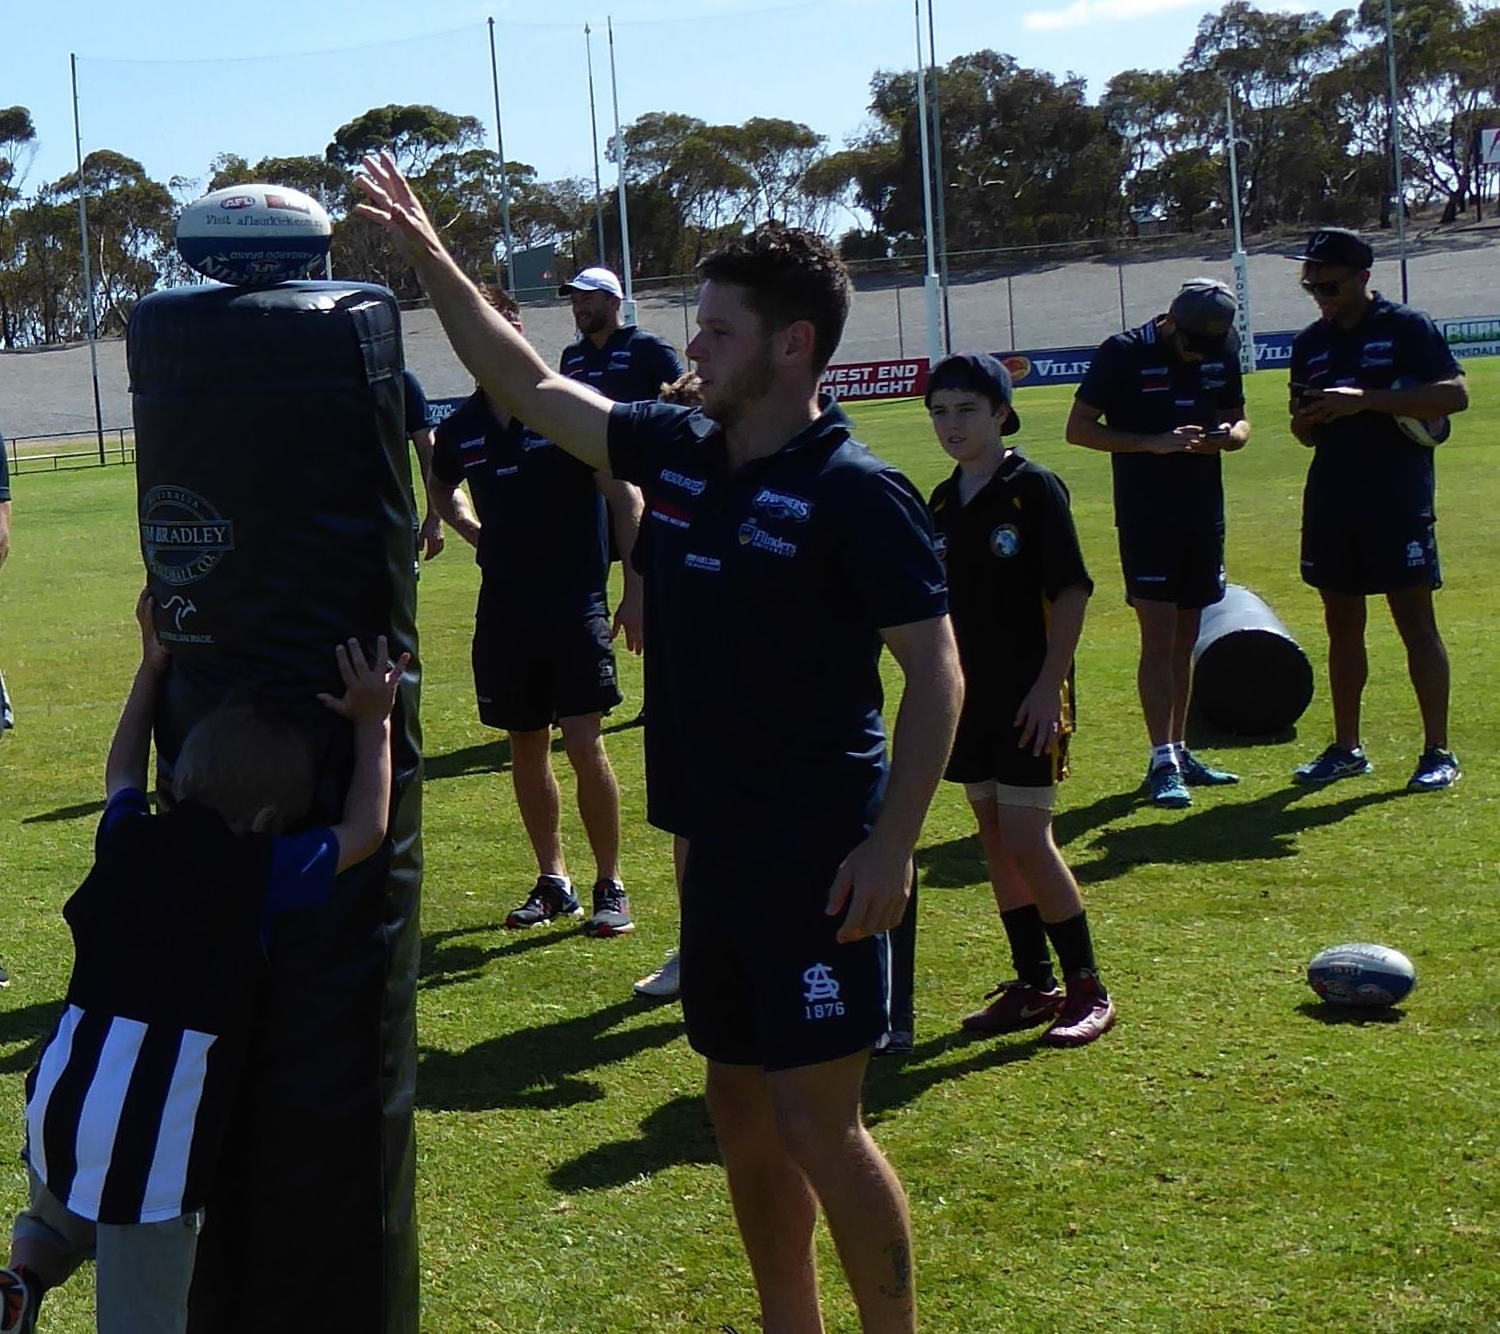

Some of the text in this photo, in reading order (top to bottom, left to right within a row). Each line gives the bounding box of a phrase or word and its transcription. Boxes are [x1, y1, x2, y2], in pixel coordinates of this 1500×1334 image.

[820, 365, 919, 383] WEST END
[820, 380, 916, 397] DRAUGHT
[156, 527, 227, 544] BRADLEY
[804, 1001, 845, 1020] 1876
